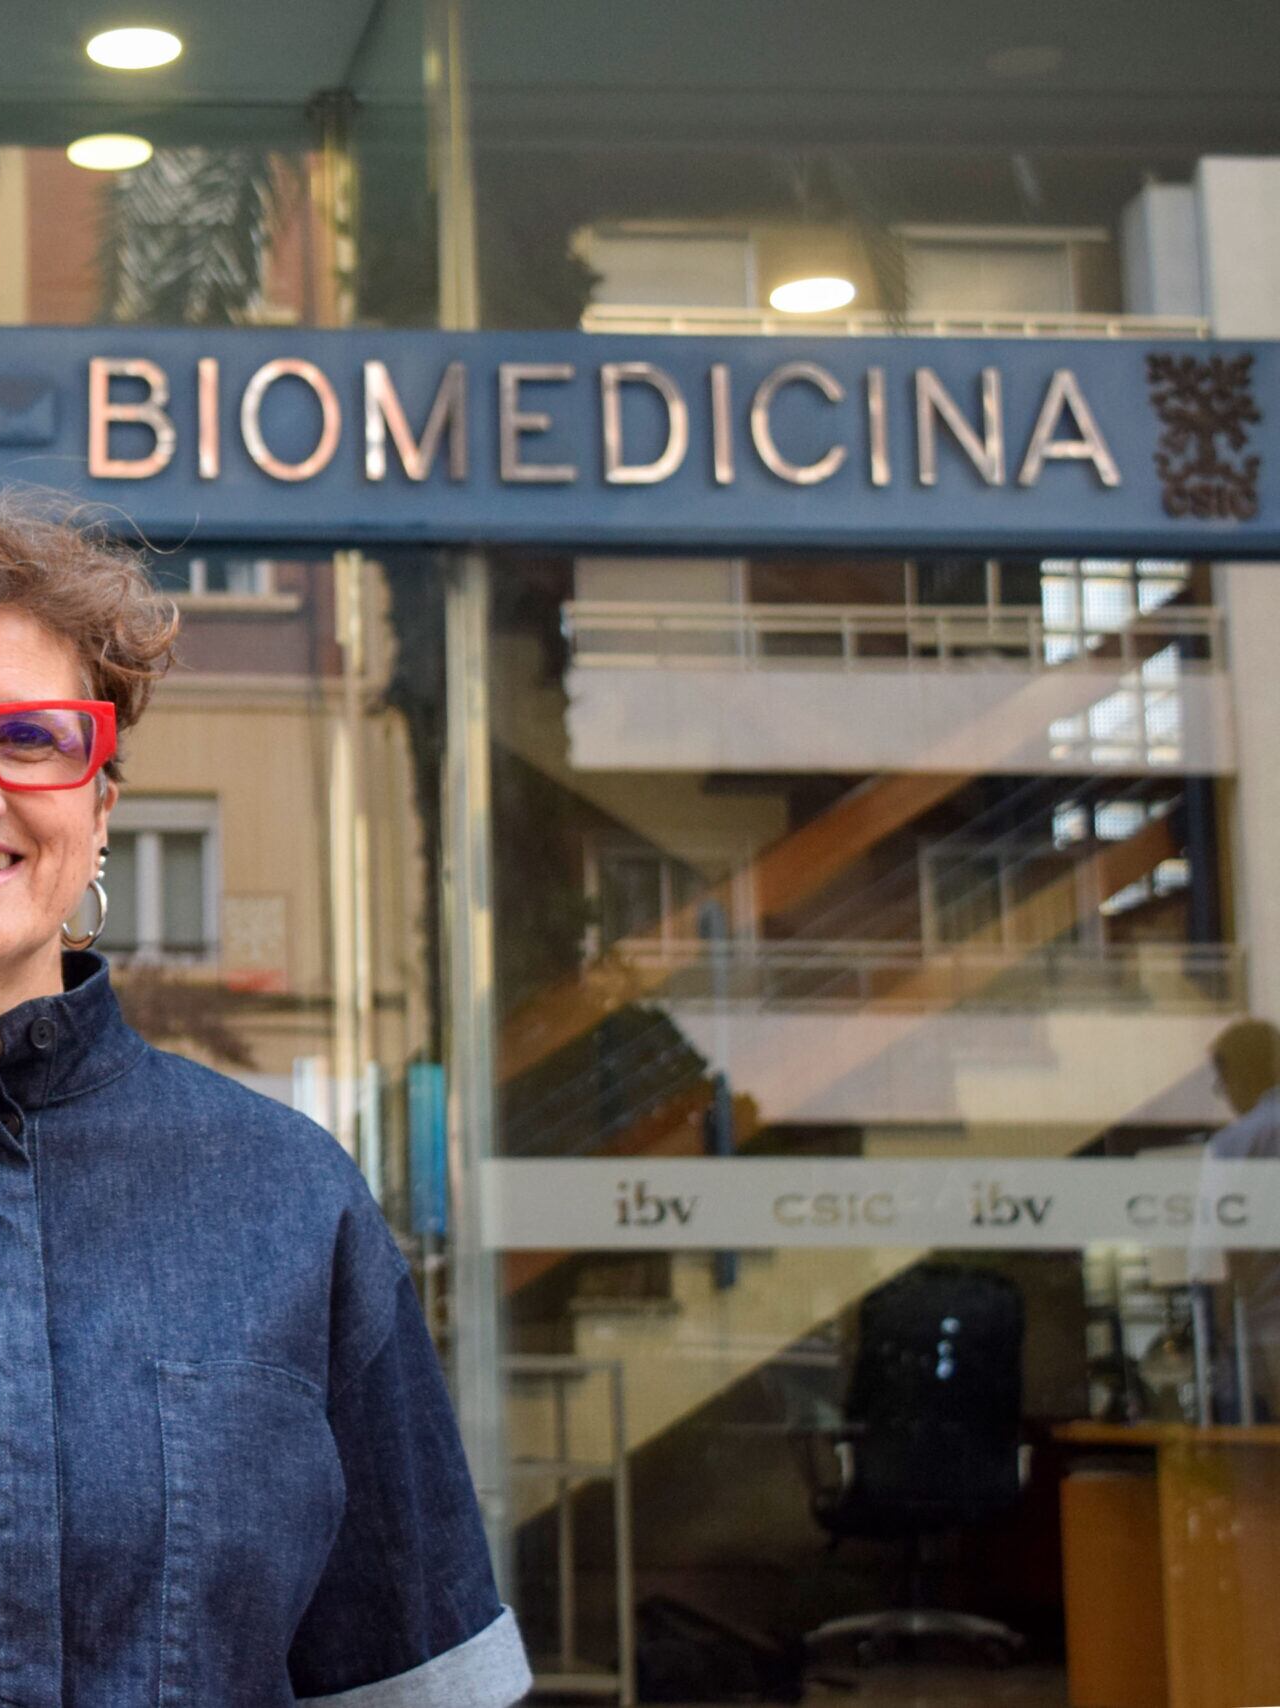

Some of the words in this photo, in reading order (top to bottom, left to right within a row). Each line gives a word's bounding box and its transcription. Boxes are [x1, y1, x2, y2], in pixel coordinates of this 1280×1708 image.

[87, 357, 1121, 487] BIOMEDICINA
[616, 1181, 697, 1225] ibv
[773, 1193, 896, 1227] CSIC
[971, 1182, 1053, 1227] ibv
